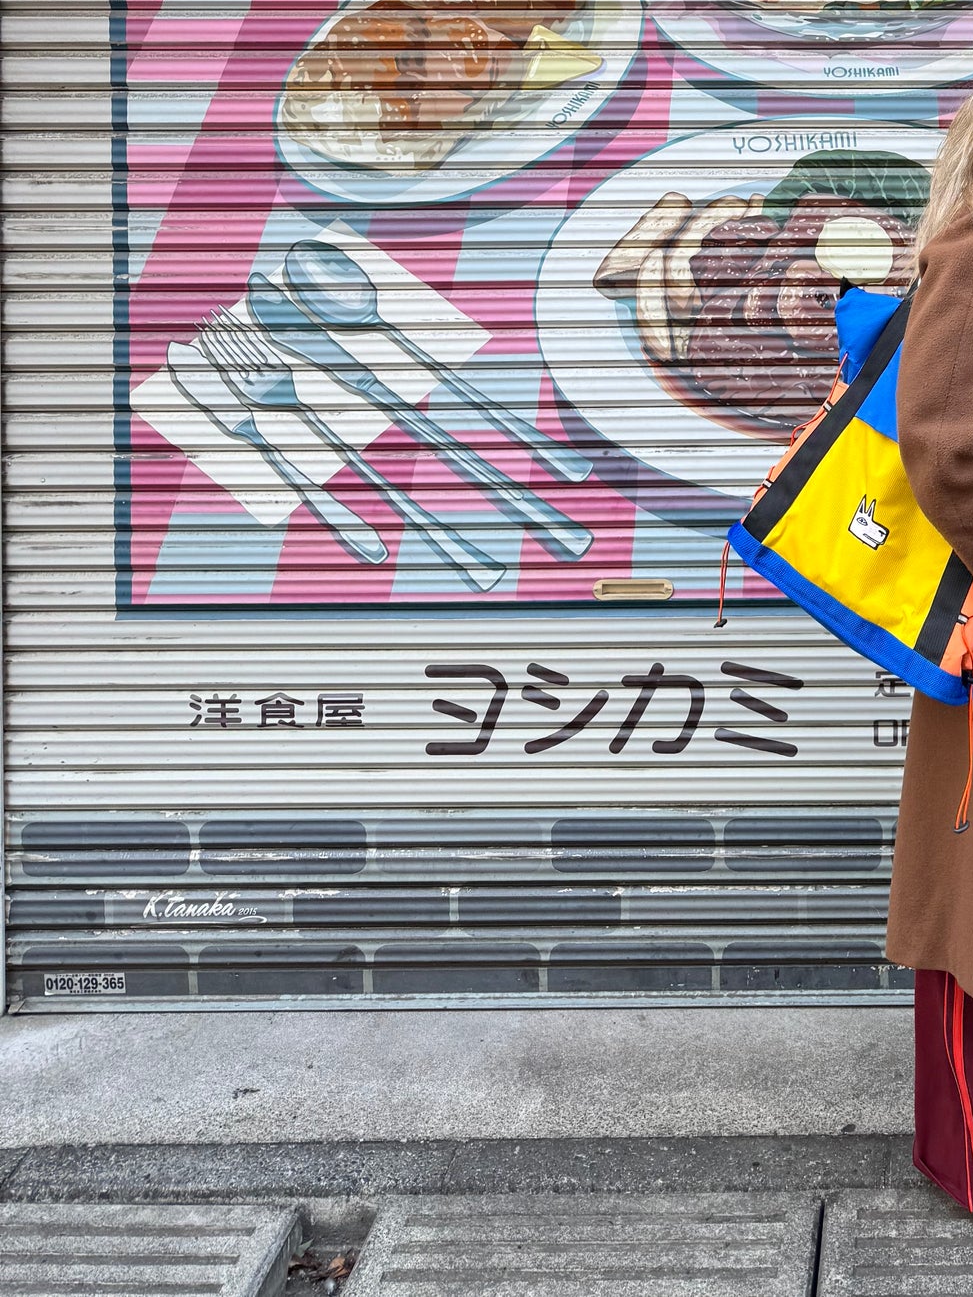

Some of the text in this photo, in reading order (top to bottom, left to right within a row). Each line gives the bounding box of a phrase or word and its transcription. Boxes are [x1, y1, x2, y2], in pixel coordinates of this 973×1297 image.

[823, 66, 899, 78] YOSHIKAMI
[545, 81, 600, 128] YOSHIKAMI
[732, 131, 857, 154] YOSHIKAMI
[189, 662, 804, 757] 洋食屋 ヨシカミ
